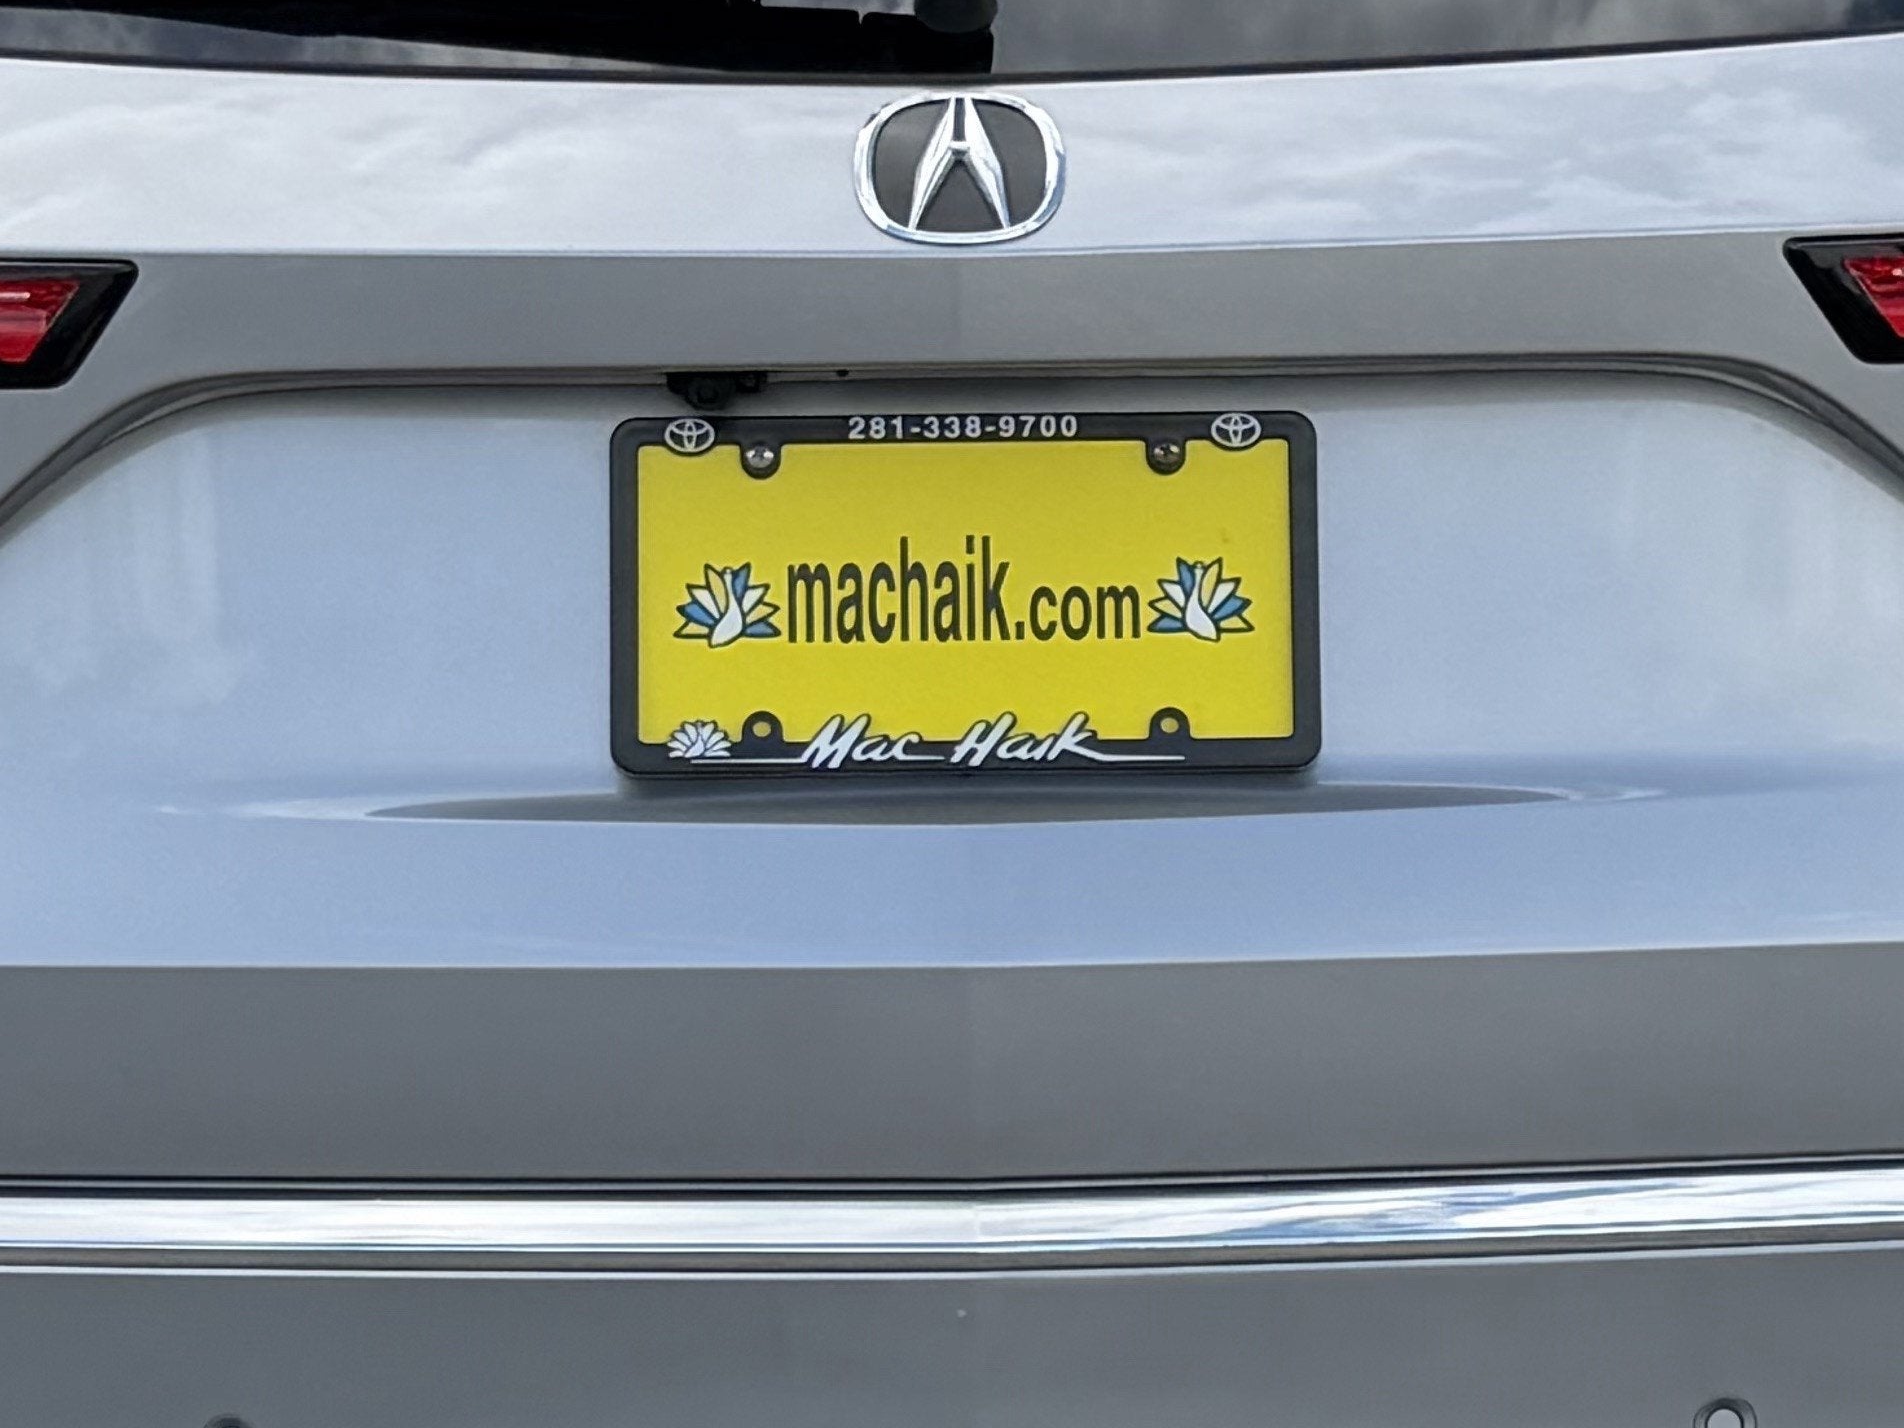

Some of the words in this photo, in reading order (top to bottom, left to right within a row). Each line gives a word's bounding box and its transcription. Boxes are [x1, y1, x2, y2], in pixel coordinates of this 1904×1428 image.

[847, 414, 1079, 440] 281-338-9700
[786, 535, 1141, 644] machaik.com
[794, 712, 944, 770] Mac
[949, 712, 1106, 769] Haik
